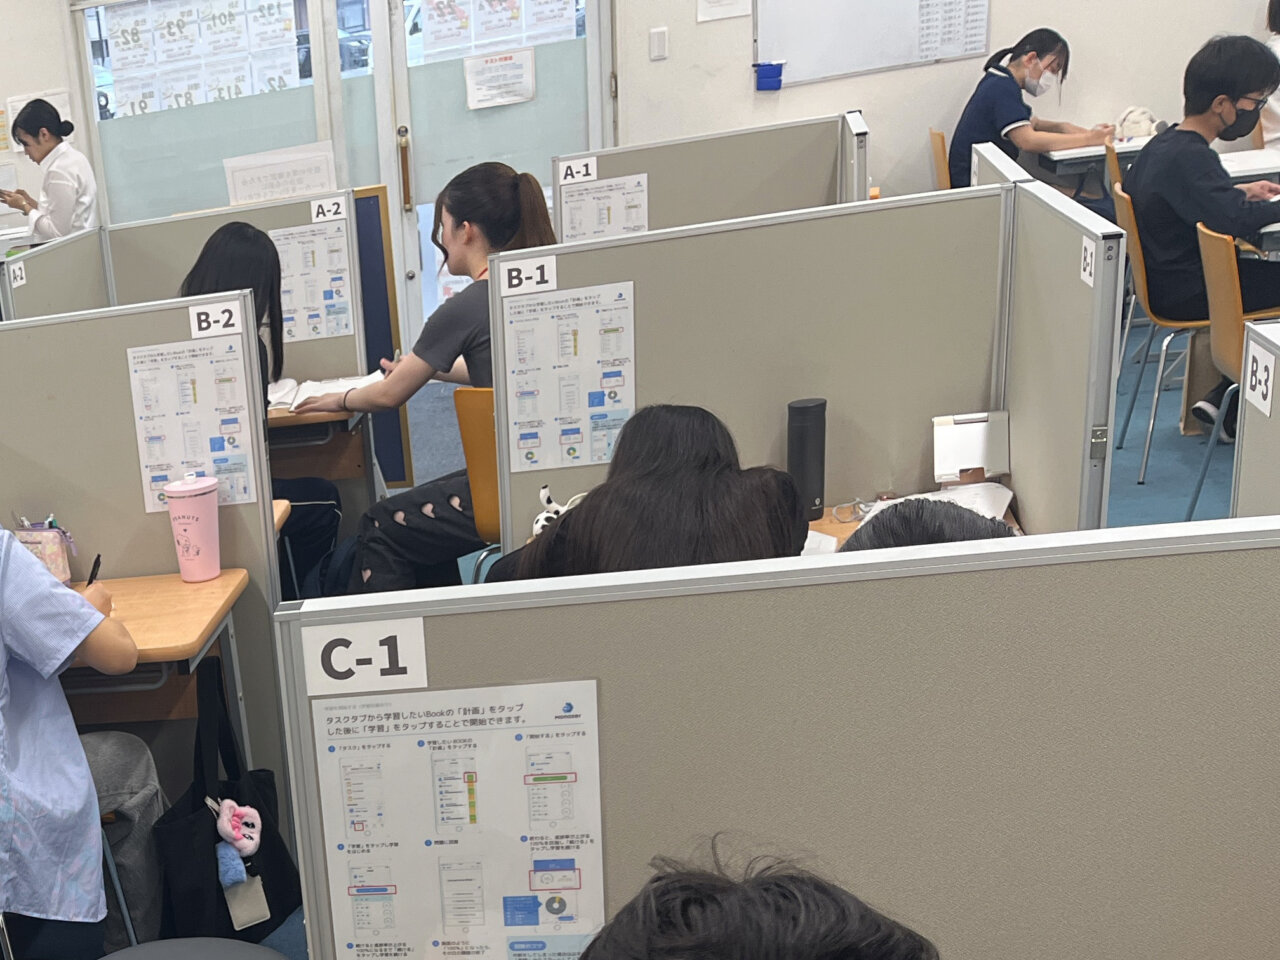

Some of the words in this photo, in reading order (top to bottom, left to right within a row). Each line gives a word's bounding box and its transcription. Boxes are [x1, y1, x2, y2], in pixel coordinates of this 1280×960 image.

[563, 163, 592, 180] A-1
[315, 202, 342, 219] A-2
[1082, 246, 1094, 278] B-1
[507, 264, 549, 289] B-1
[196, 308, 235, 332] B-2
[1250, 354, 1271, 402] B-3
[320, 635, 408, 681] C-1
